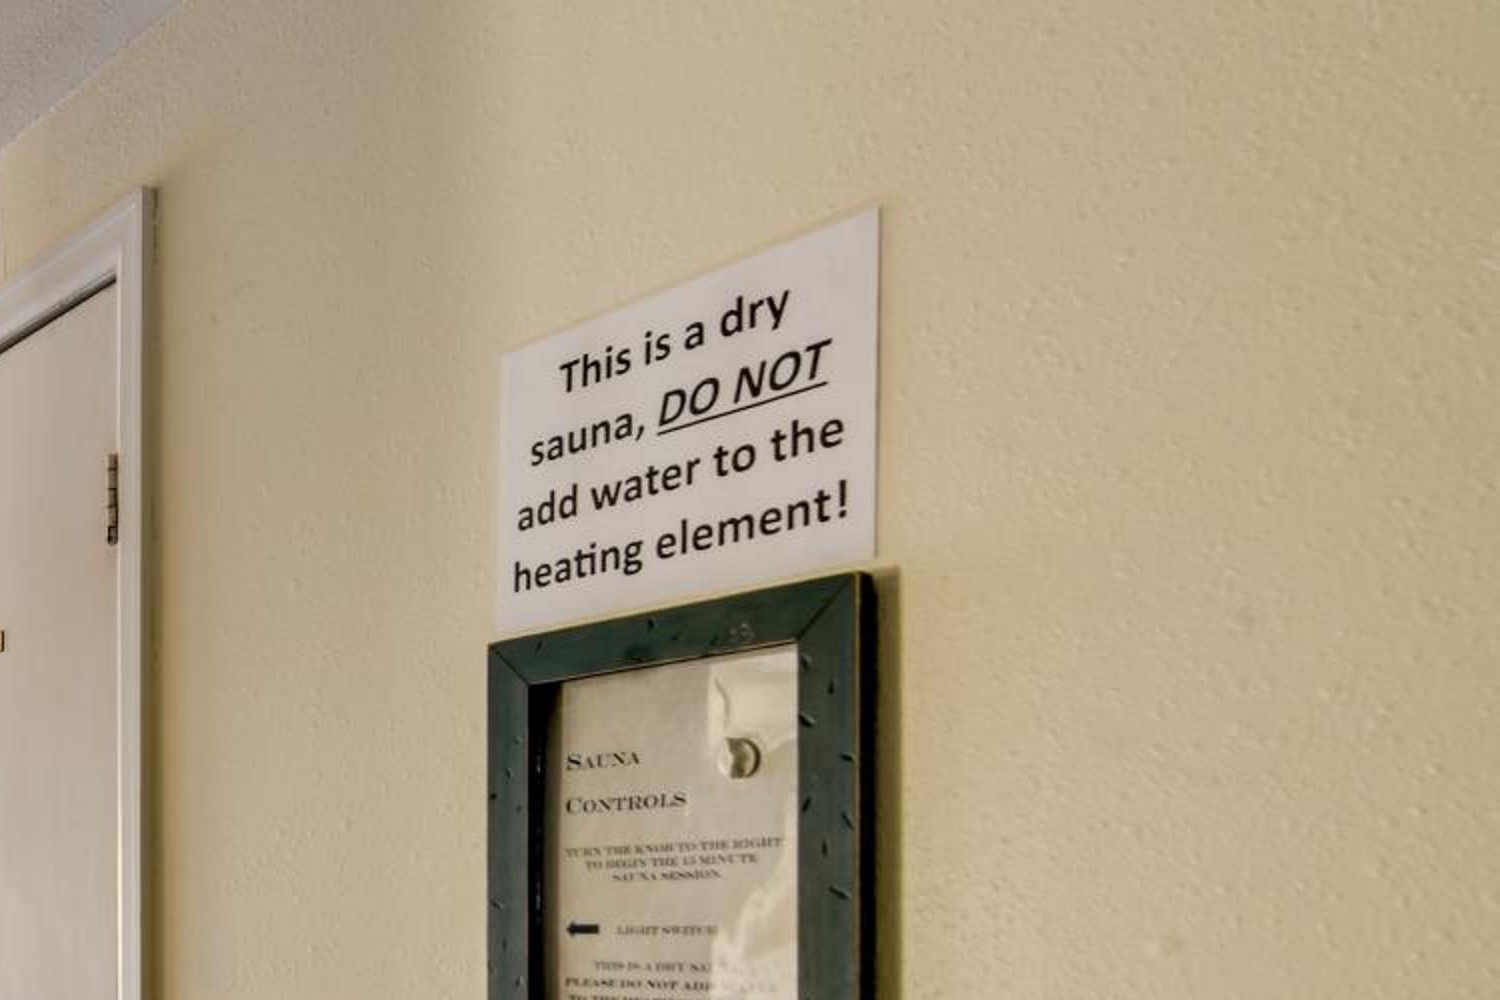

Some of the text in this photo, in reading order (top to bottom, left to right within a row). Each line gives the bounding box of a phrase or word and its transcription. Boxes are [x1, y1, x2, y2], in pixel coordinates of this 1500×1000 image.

[559, 289, 791, 394] This is a dry
[530, 338, 833, 467] sauna, DO NOT
[516, 418, 845, 532] add water to the
[513, 479, 849, 593] heating element!
[565, 792, 688, 815] CONTROLS
[566, 751, 641, 771] SAUNA
